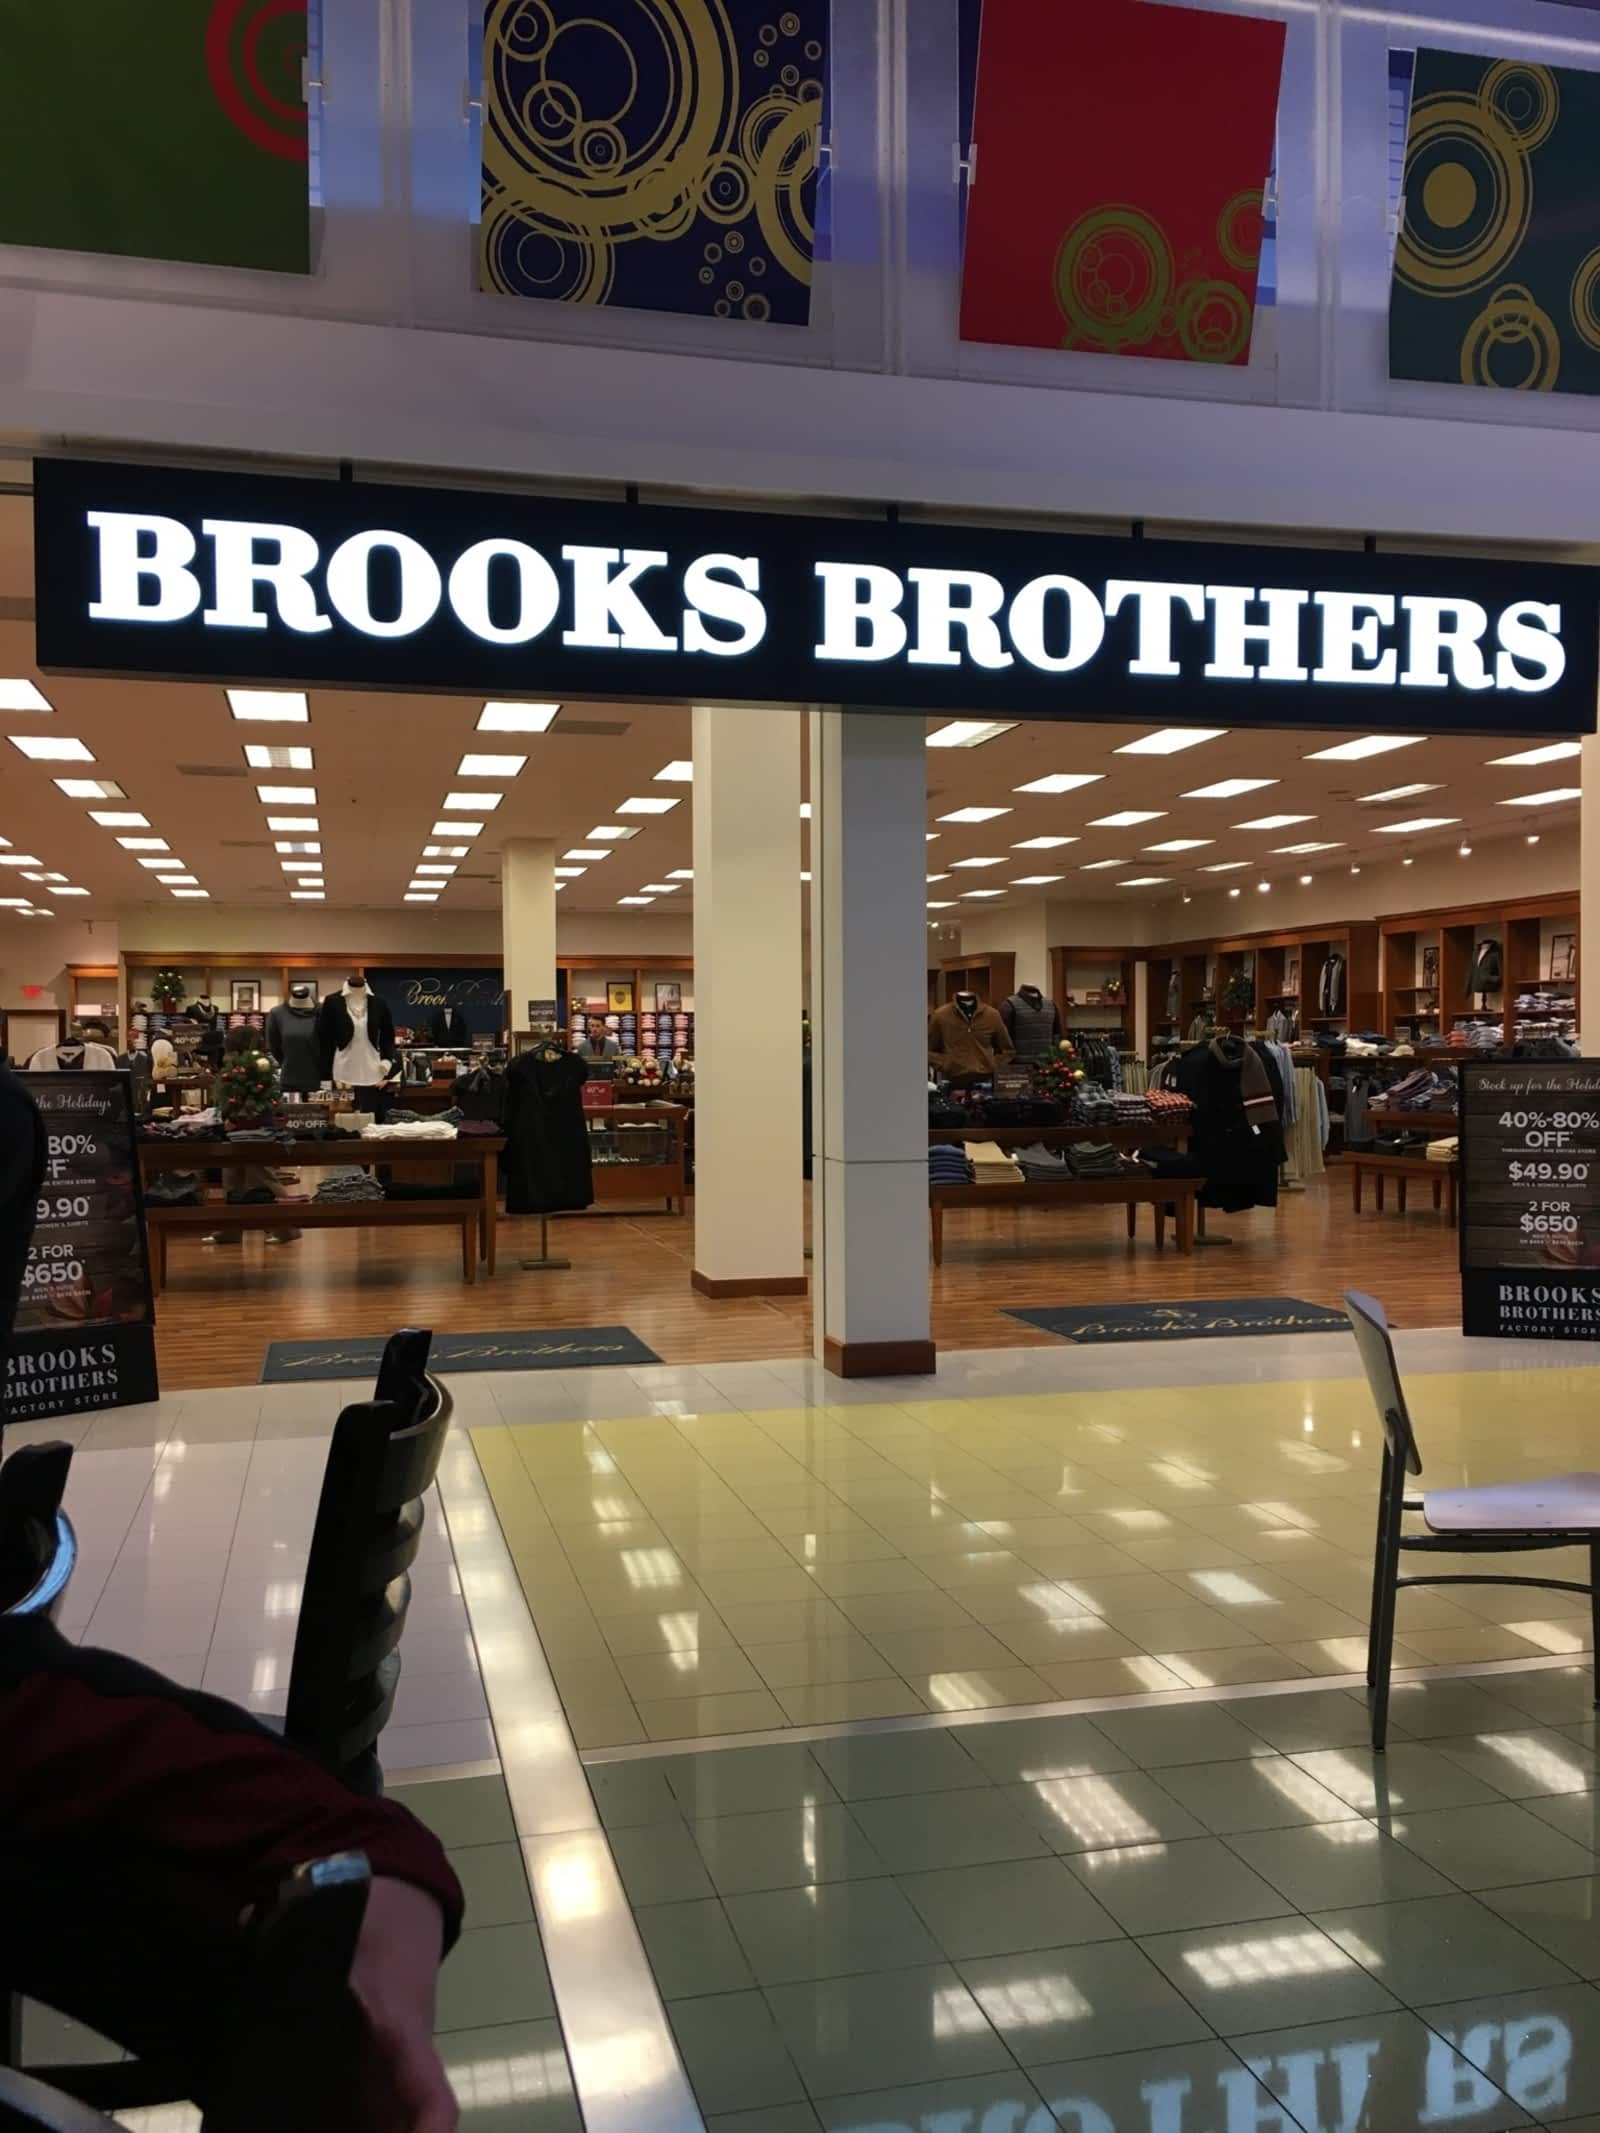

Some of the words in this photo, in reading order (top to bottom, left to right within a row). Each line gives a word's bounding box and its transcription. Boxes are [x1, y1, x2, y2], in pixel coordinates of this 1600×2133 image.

[87, 511, 767, 656] BROOKS
[814, 562, 1566, 692] BROTHERS
[1479, 1078, 1505, 1090] Stock
[1510, 1082, 1522, 1095] up
[1526, 1078, 1541, 1095] for
[1546, 1079, 1560, 1090] the
[1566, 1078, 1600, 1090] Holid
[55, 1094, 111, 1115] Holidays
[1499, 1111, 1600, 1128] 40%-80%
[1529, 1201, 1538, 1211] 2
[1542, 1201, 1570, 1212] FOR
[28, 1247, 37, 1260] 2
[42, 1244, 74, 1258] FOR
[1499, 1285, 1600, 1304] BROOKS
[1499, 1324, 1555, 1333] FACTORY
[1564, 1326, 1600, 1335] STOR
[9, 1400, 65, 1415] ACTORY
[75, 1391, 119, 1405] STORE
